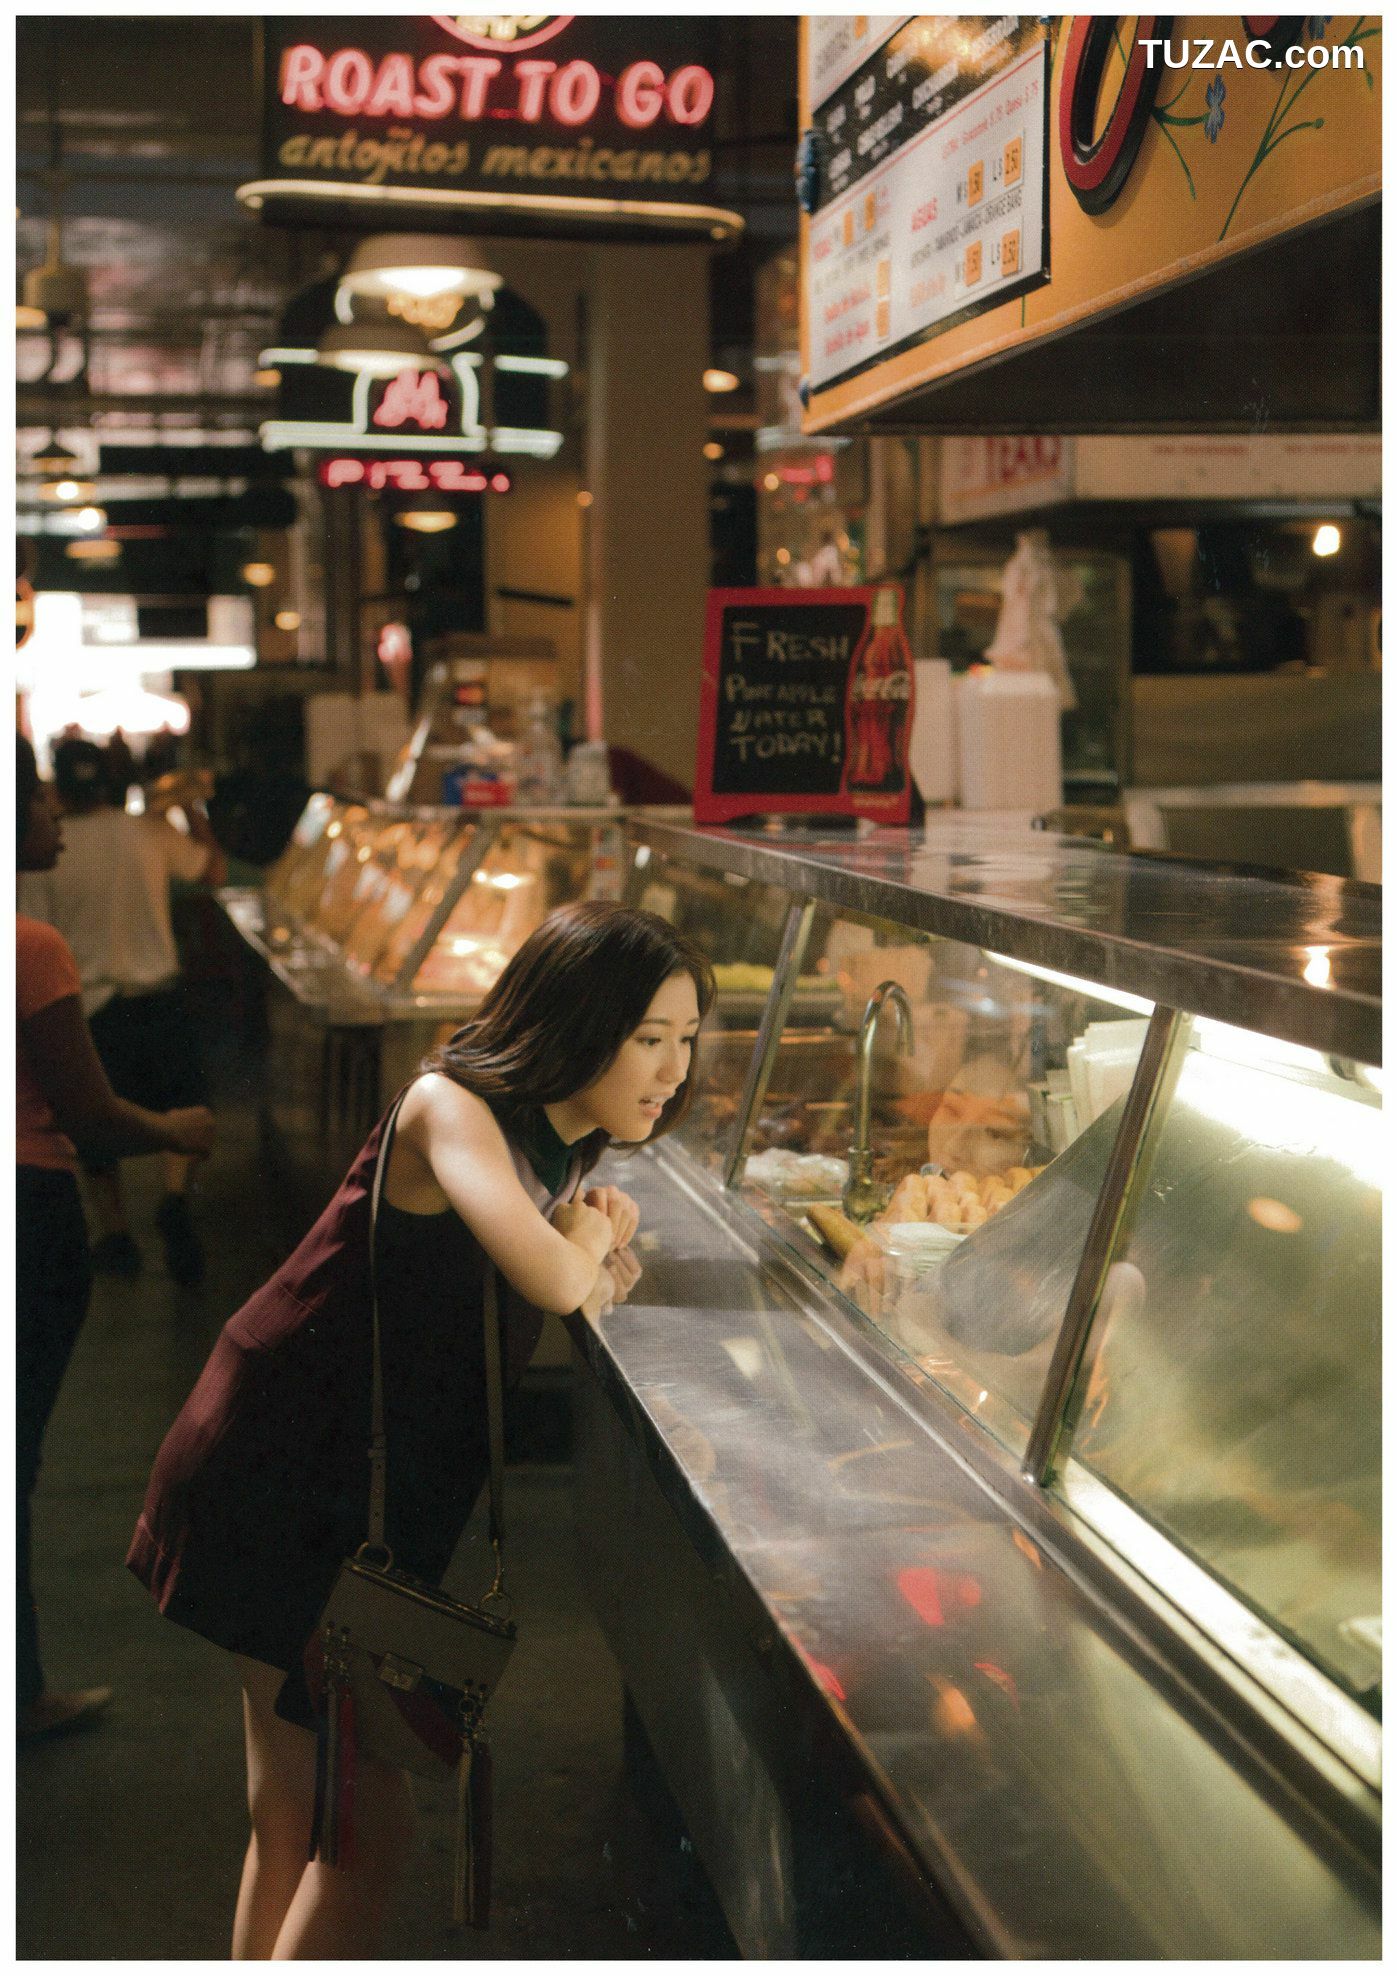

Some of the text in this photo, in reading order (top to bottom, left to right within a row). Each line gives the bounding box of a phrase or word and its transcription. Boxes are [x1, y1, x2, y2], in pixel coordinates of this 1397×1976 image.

[281, 44, 714, 127] ROAST TO GO
[278, 128, 711, 184] antojitos mexicanos
[731, 621, 850, 663] FRESH
[728, 728, 842, 764] TODAY!
